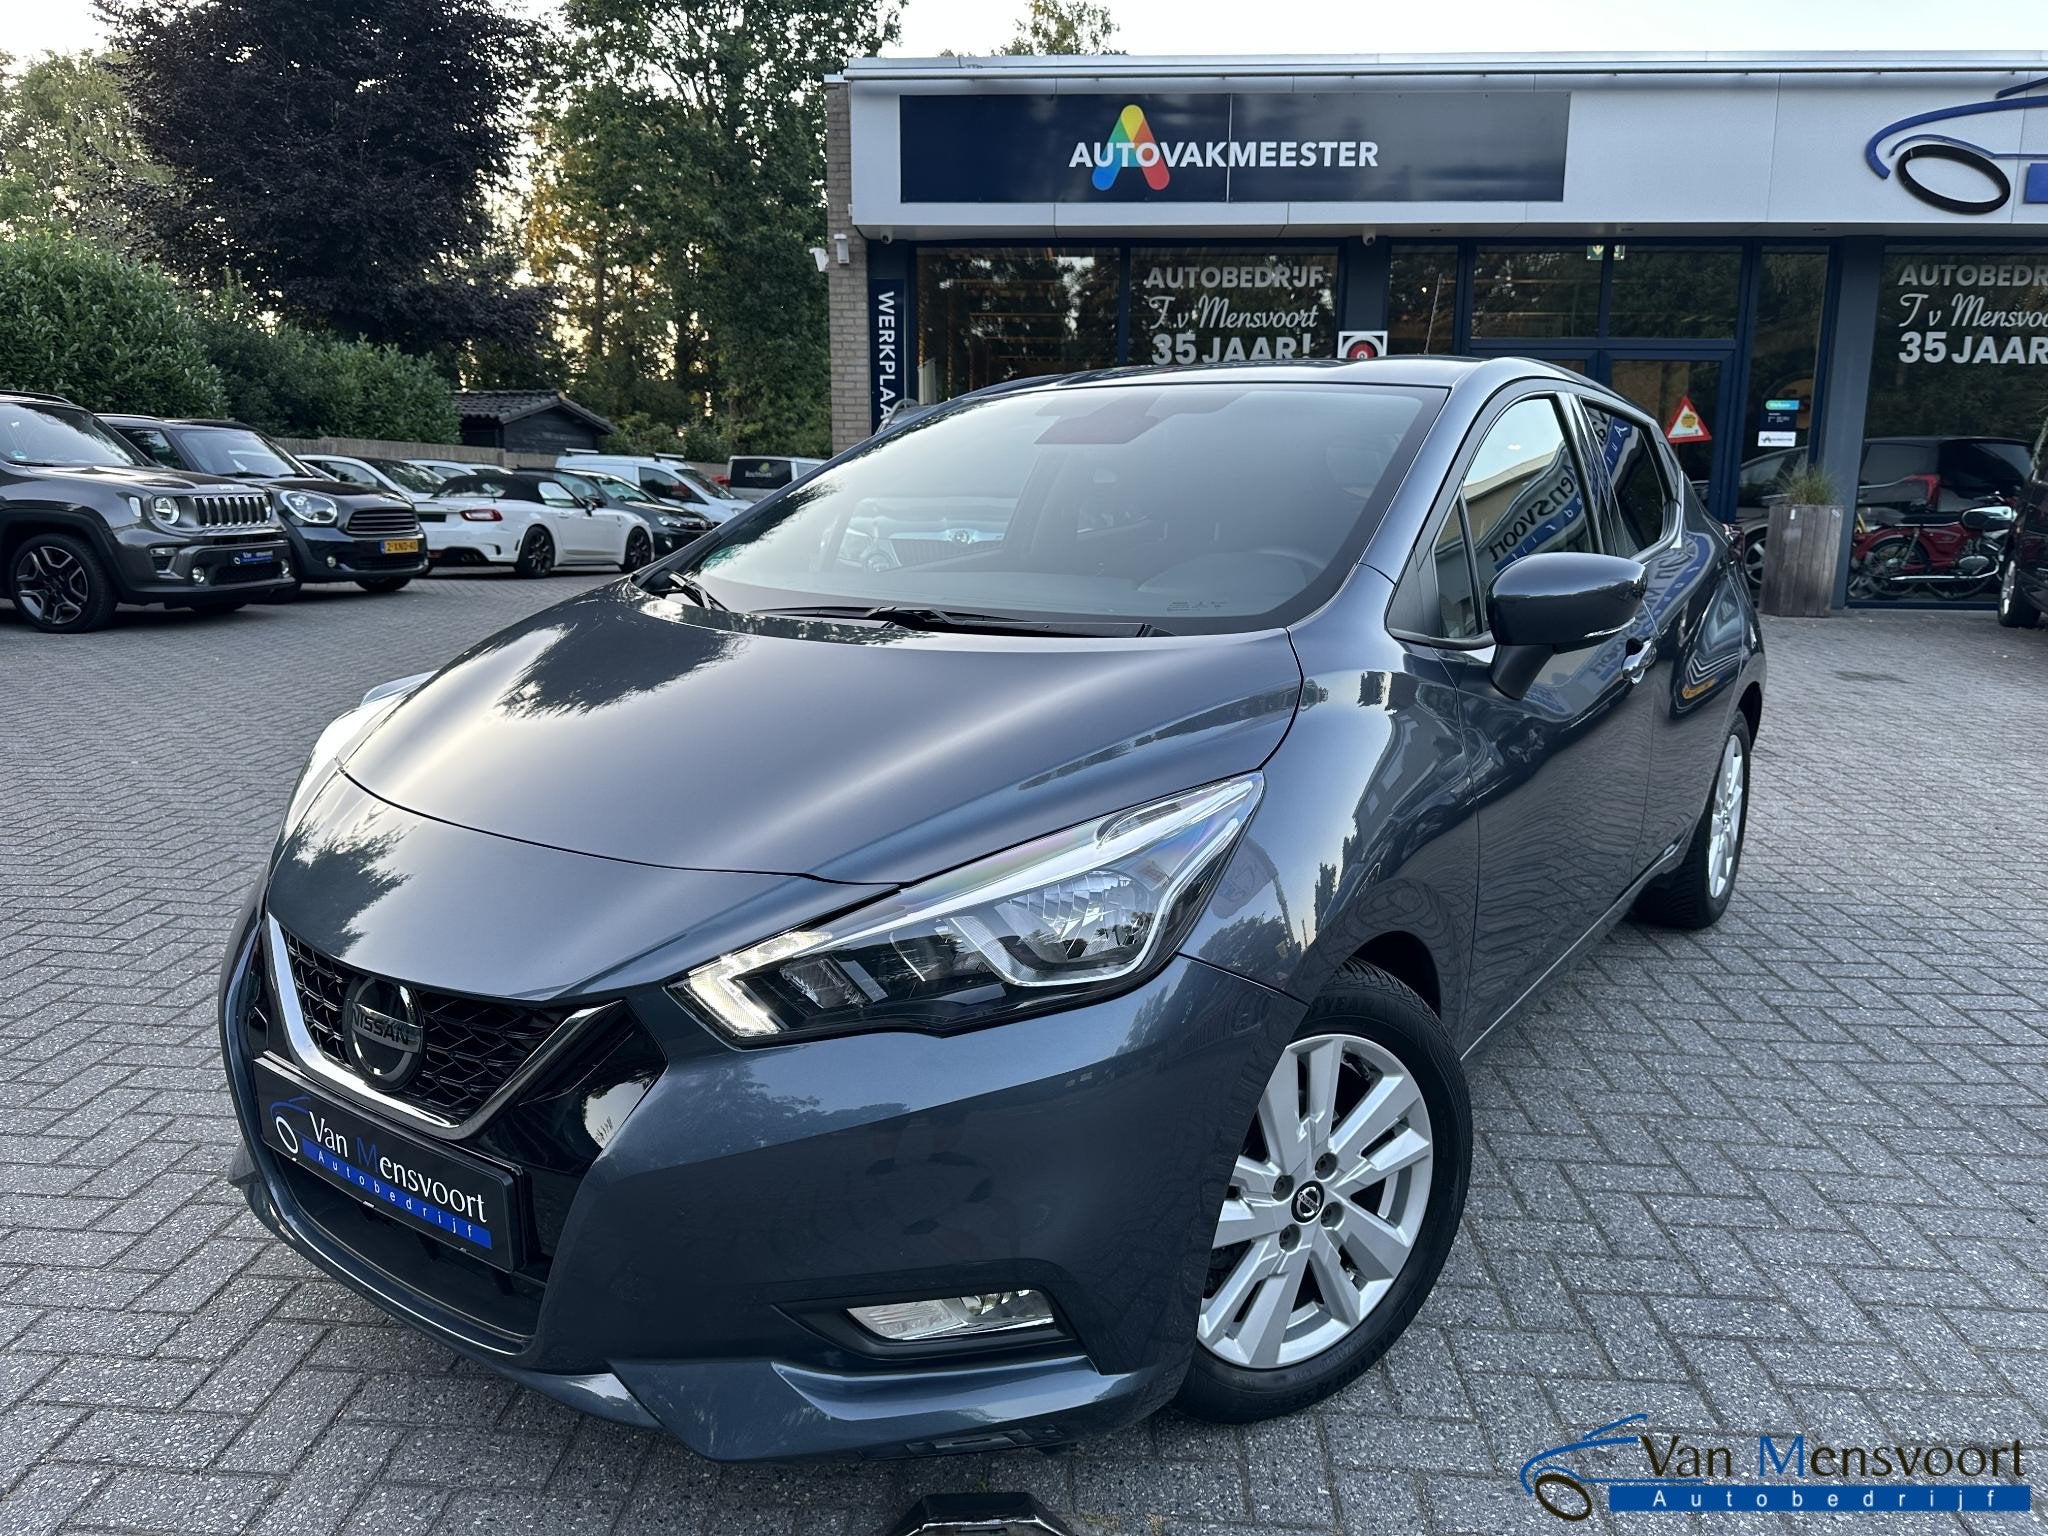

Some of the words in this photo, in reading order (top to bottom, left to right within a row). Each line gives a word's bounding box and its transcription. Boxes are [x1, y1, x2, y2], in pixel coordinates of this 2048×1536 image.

[1069, 141, 1379, 168] AUTOVAKMEESTER
[1148, 266, 1324, 289] AUTOBEDRIJF
[1199, 295, 1319, 329] Mensvoort
[1929, 310, 1942, 326] v
[1152, 333, 1197, 365] 35
[1202, 333, 1312, 364] JAAR!
[1899, 331, 1947, 363] 35
[352, 1006, 409, 1045] NISSAN
[310, 1111, 348, 1157] Van
[356, 1136, 487, 1223] Mensvoort
[318, 1151, 473, 1239] Autobedrijf
